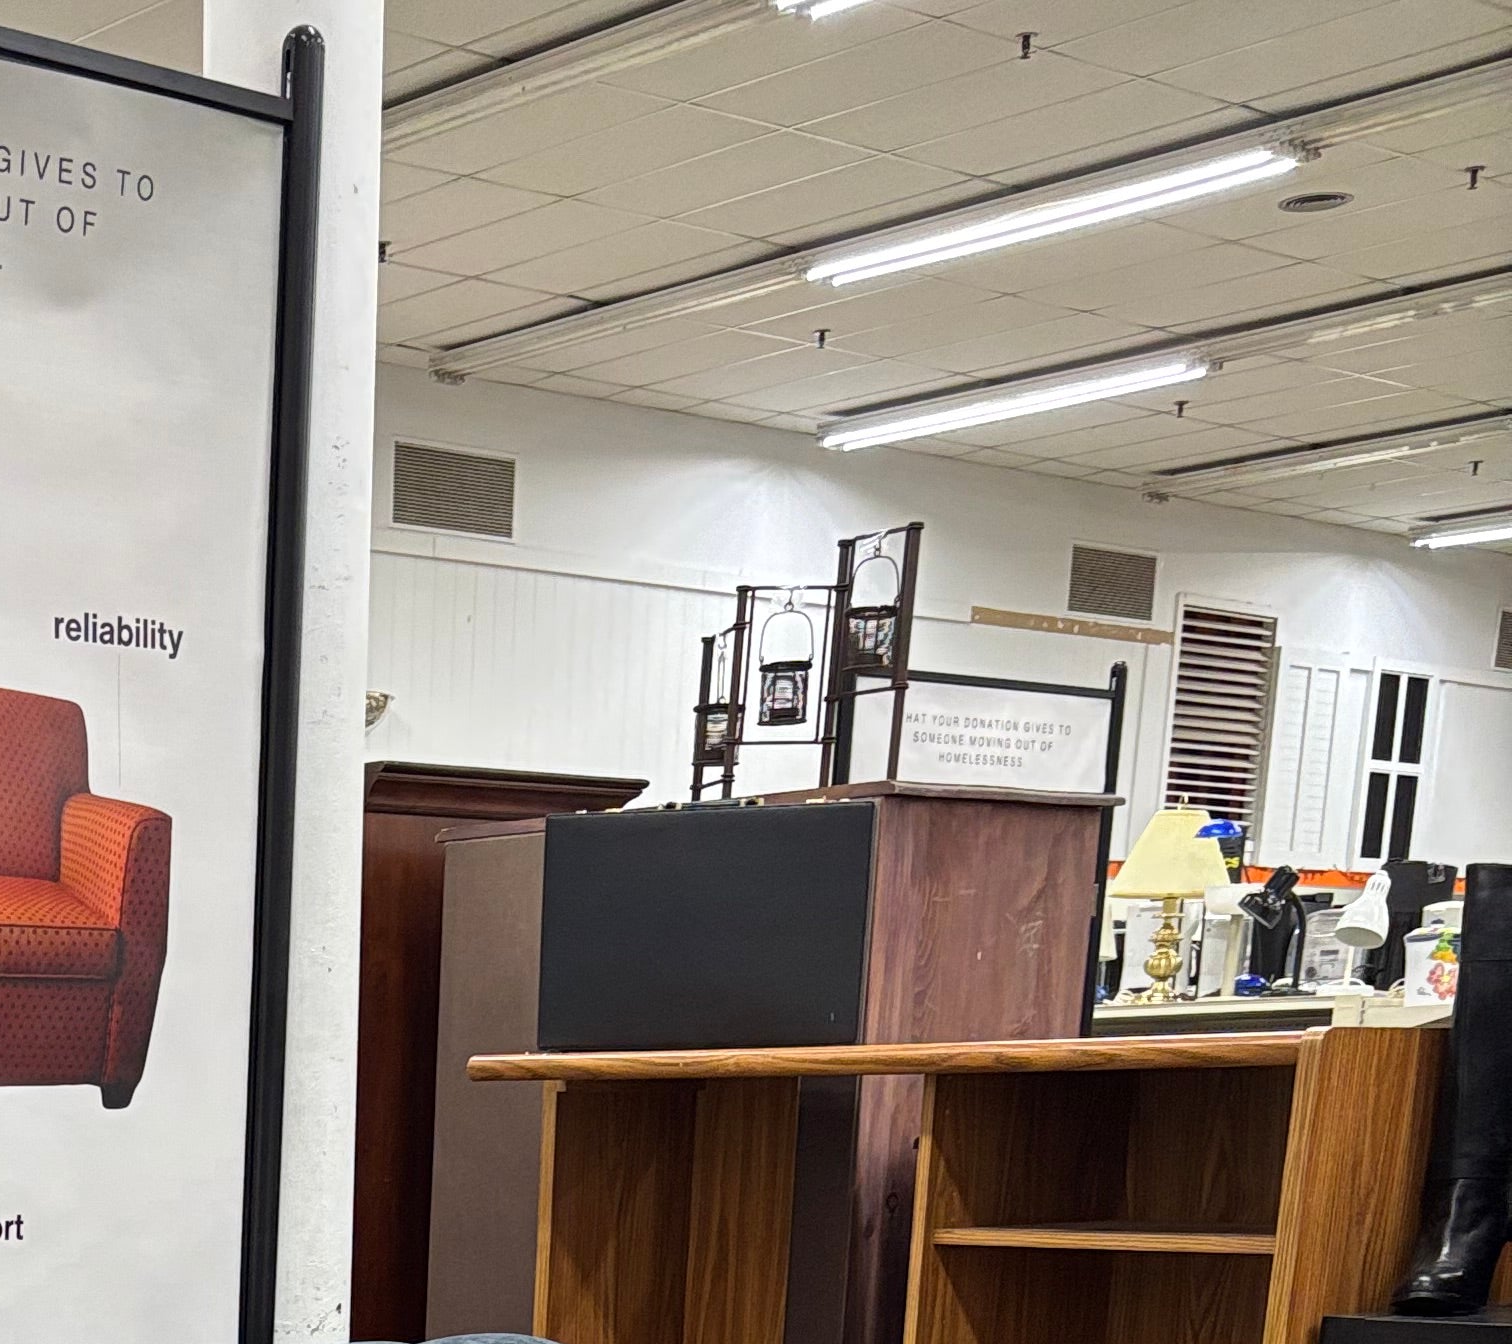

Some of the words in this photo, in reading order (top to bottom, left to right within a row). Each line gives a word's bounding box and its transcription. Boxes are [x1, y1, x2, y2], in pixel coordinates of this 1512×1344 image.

[116, 168, 155, 202] TO
[55, 205, 98, 237] OF
[54, 612, 184, 660] reliability
[905, 712, 927, 724] HAT
[932, 714, 961, 728] YOUR
[963, 716, 1019, 732] DONATION
[1023, 720, 1054, 735] GIVES
[1058, 724, 1072, 737] TO
[912, 730, 965, 746] SOMEONE
[969, 734, 1012, 750] MOVING
[1015, 738, 1037, 751] OUT
[1039, 740, 1054, 752] OF
